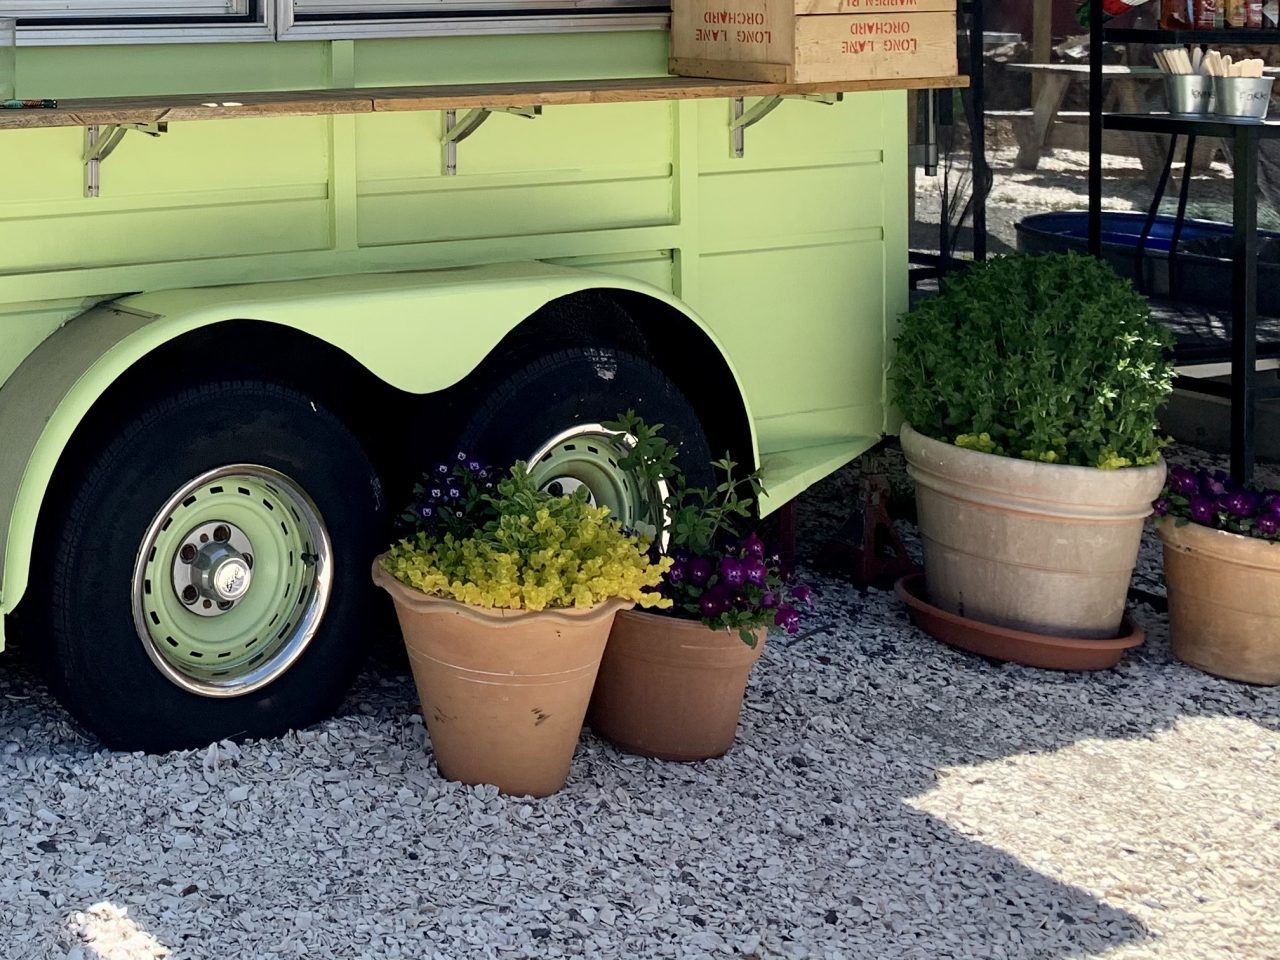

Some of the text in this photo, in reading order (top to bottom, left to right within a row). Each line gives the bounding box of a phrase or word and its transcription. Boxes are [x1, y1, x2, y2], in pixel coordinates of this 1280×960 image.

[703, 12, 764, 25] ORCHARD
[850, 21, 910, 35] ORCHARD
[695, 28, 771, 44] LONG LANE
[841, 37, 917, 54] LONG LANE
